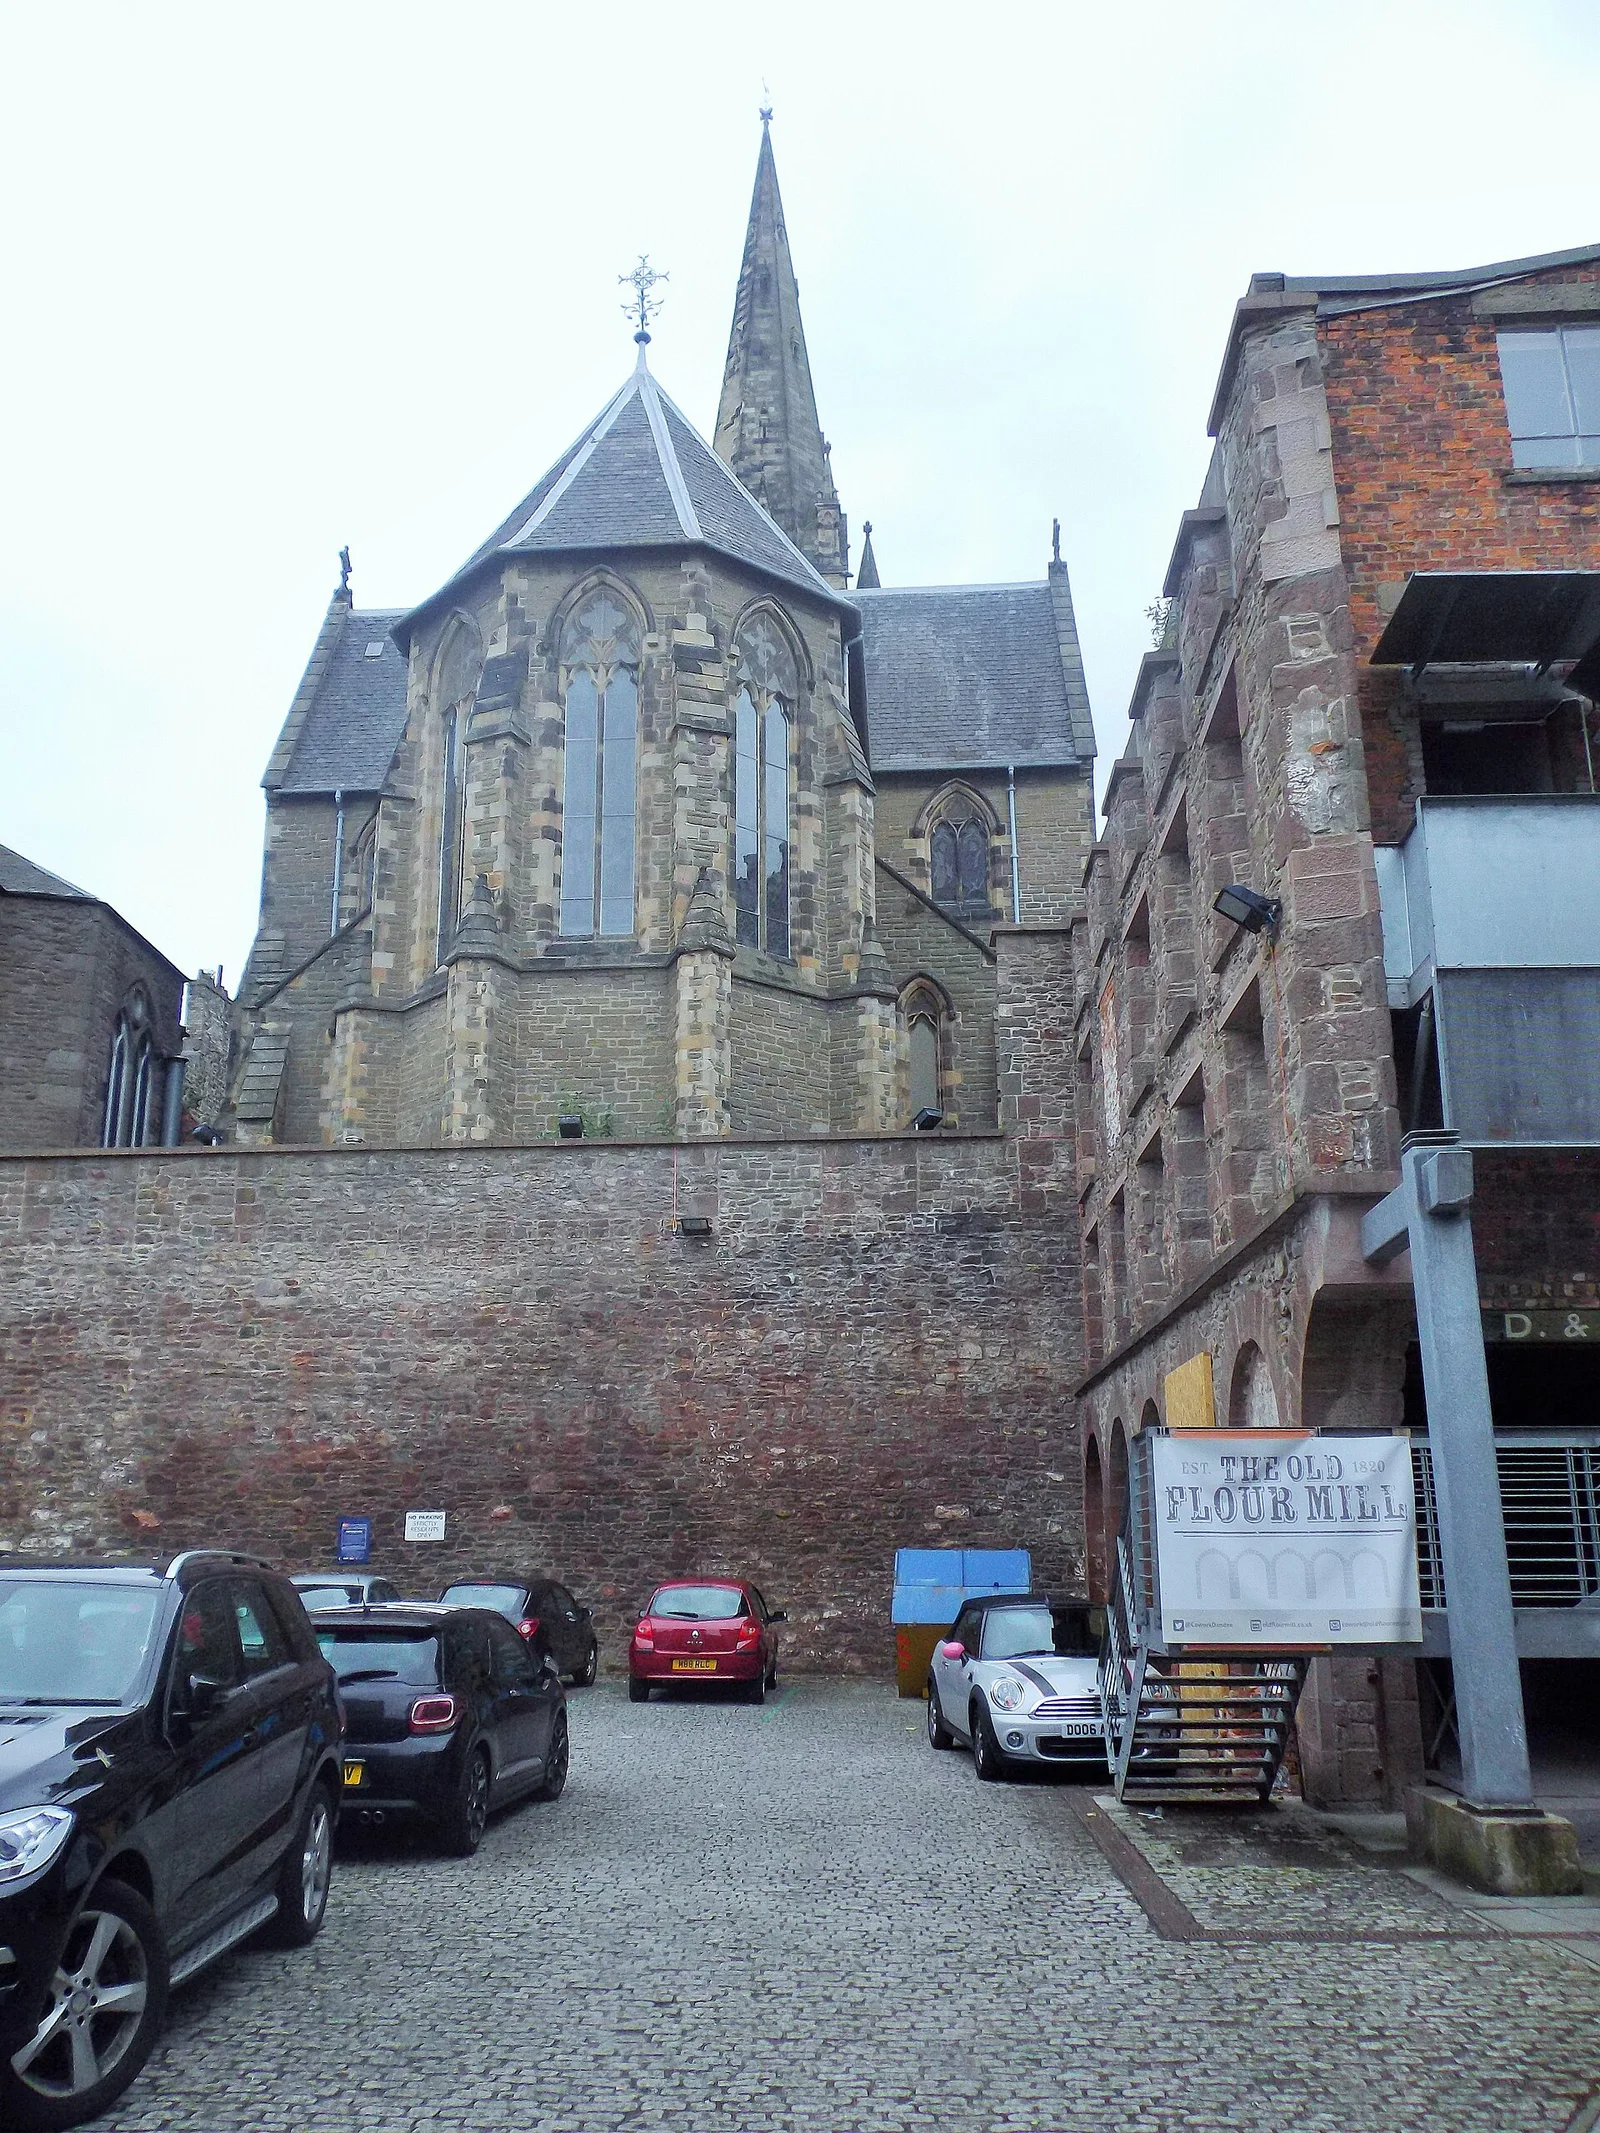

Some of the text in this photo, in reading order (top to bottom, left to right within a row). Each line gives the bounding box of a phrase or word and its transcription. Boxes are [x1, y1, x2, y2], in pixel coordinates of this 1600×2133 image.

[1563, 1313, 1590, 1338] &
[1182, 1454, 1386, 1483] EST. THE OLD 1820
[1165, 1484, 1408, 1524] FLOUR MILL
